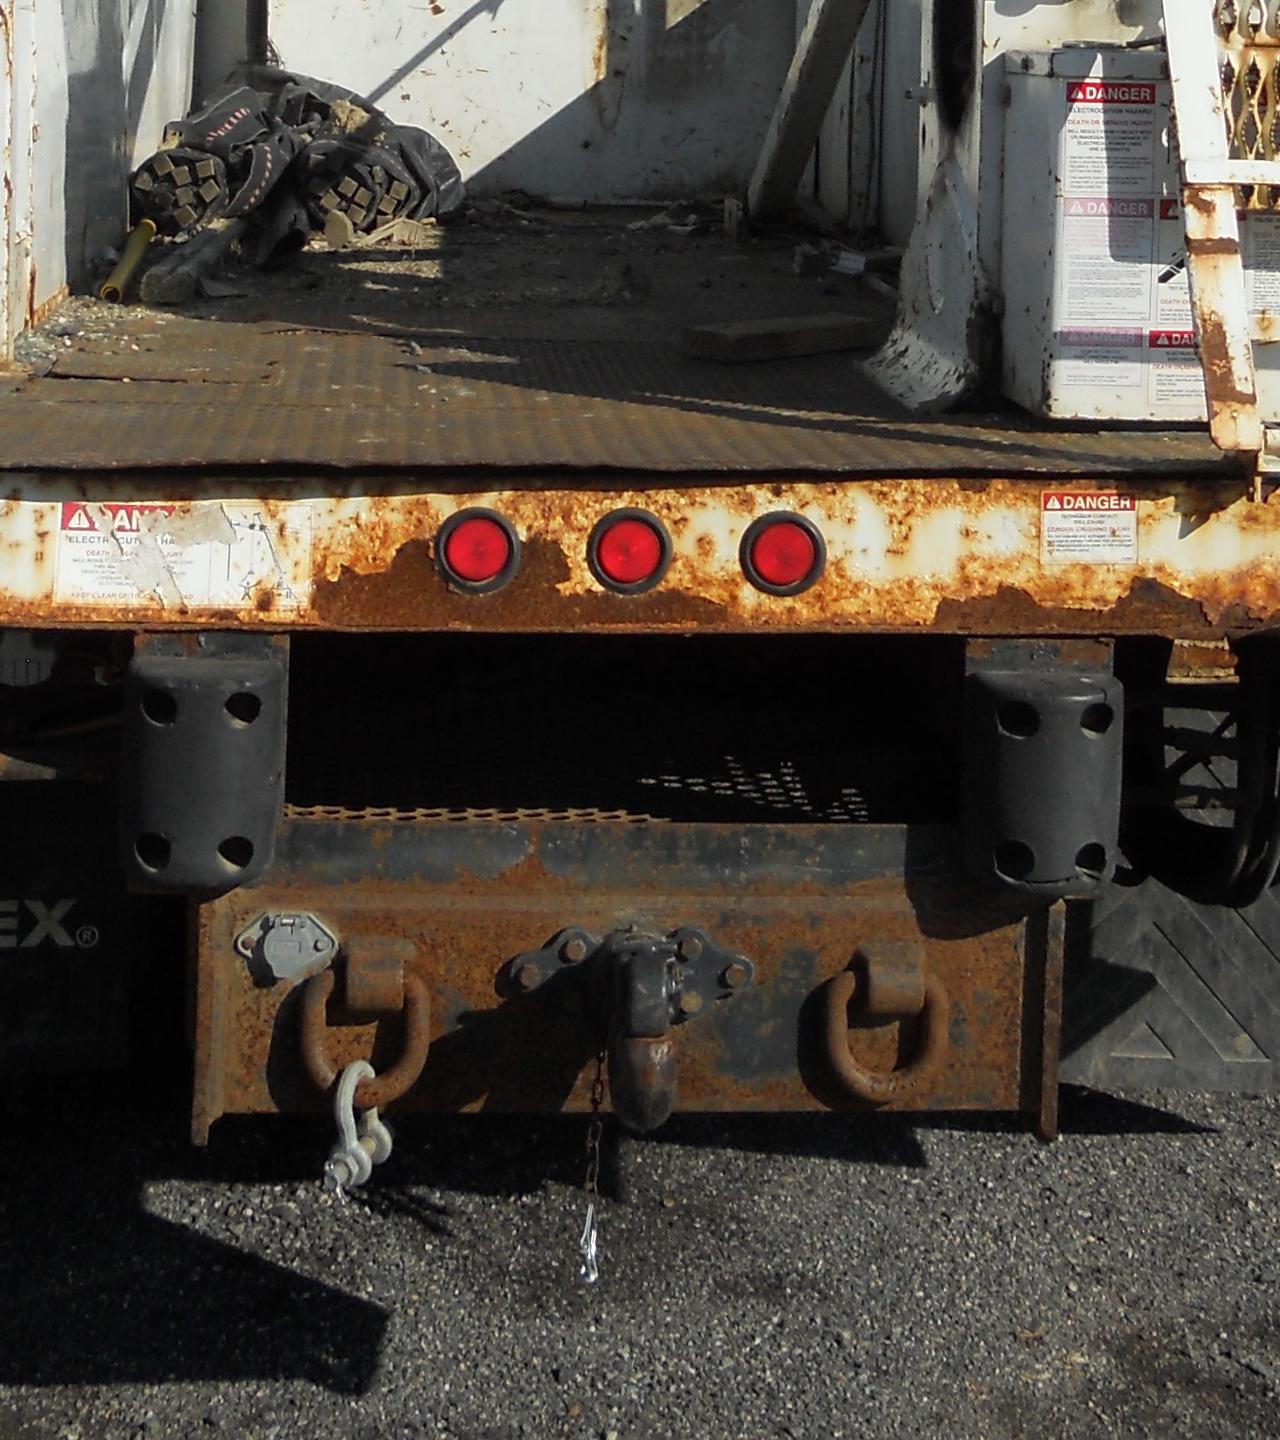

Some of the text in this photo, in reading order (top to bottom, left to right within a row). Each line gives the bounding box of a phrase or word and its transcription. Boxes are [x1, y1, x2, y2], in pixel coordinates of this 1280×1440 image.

[1085, 86, 1151, 101] DANGER
[1087, 201, 1148, 215] DANGER
[1063, 496, 1131, 510] DANGER
